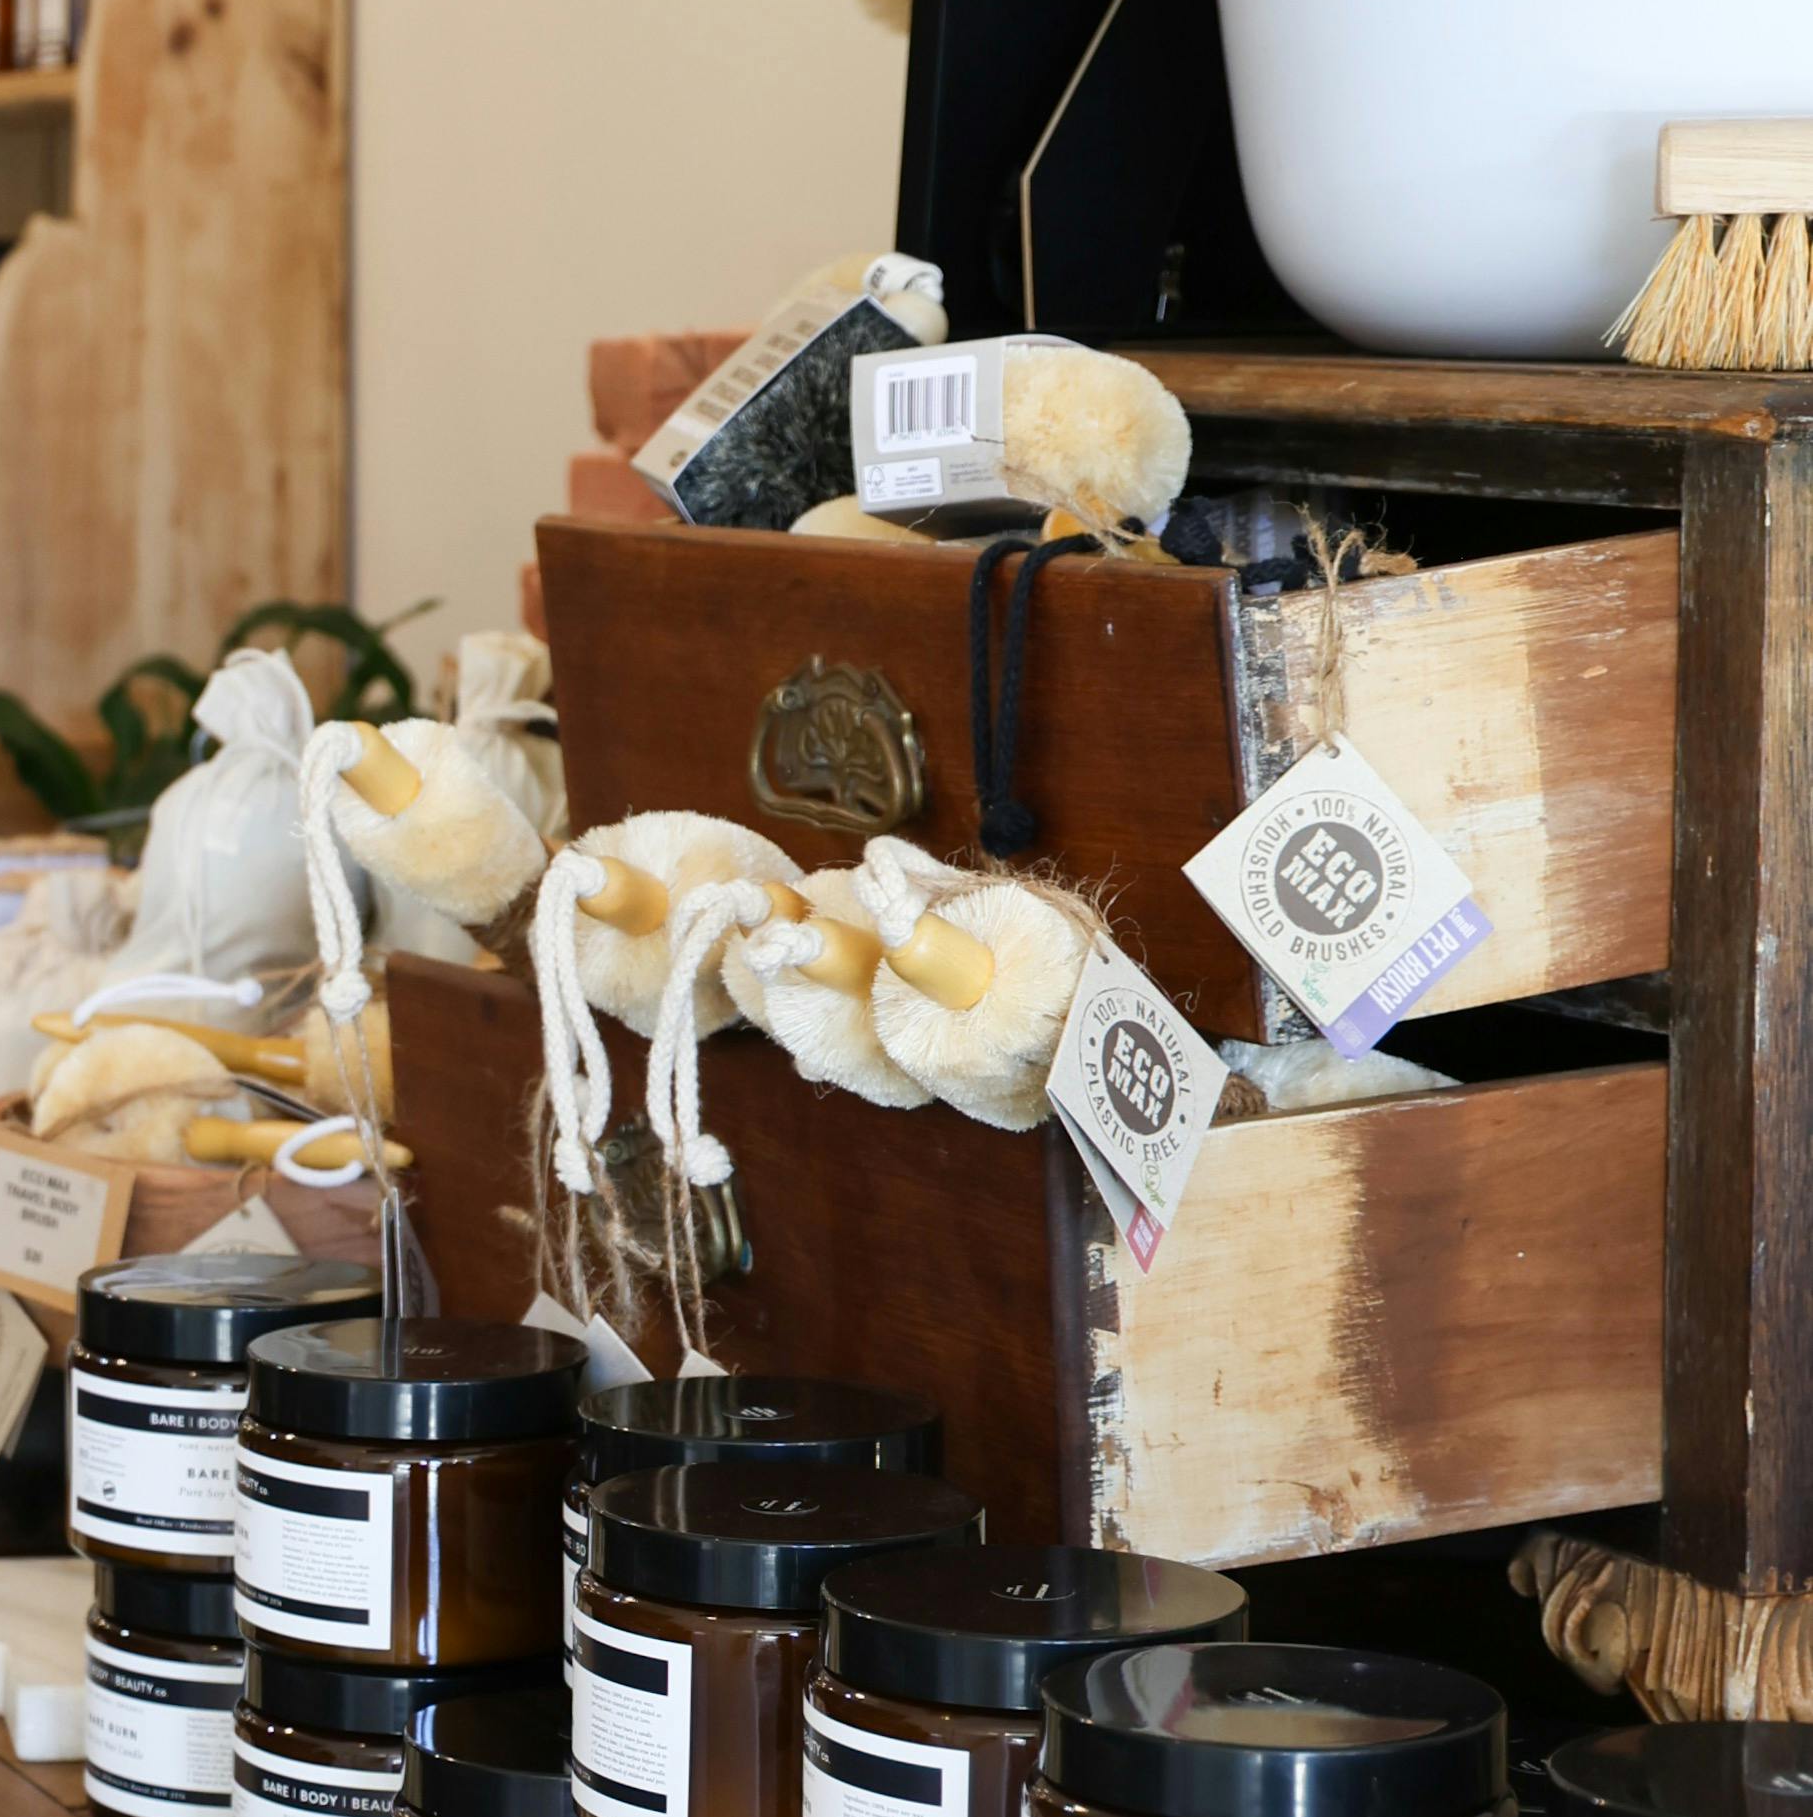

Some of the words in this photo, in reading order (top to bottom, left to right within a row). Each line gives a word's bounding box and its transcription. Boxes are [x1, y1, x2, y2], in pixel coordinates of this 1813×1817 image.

[1247, 812, 1293, 939] HOUSEHOLD
[1300, 826, 1378, 906] ECO
[1362, 812, 1407, 902] NATURAL
[1279, 852, 1358, 930] MAX
[1289, 922, 1387, 963] BRUSHES
[1416, 922, 1462, 970] PET
[1367, 952, 1431, 1016] BRUSH
[1112, 1026, 1171, 1099] ECO
[1135, 998, 1192, 1098] NATURAL
[1085, 1061, 1135, 1156] PLASTIC
[1106, 1056, 1164, 1128] MAX
[1142, 1131, 1181, 1164] FREE
[149, 1411, 185, 1428] BARE
[197, 1416, 239, 1431] BODY
[187, 1467, 231, 1481] BARE
[113, 1674, 155, 1696] BEAUTY
[108, 1722, 138, 1742] BURN
[262, 1777, 290, 1799] BARE
[299, 1789, 339, 1807] BODY
[350, 1797, 394, 1813] BEAU
